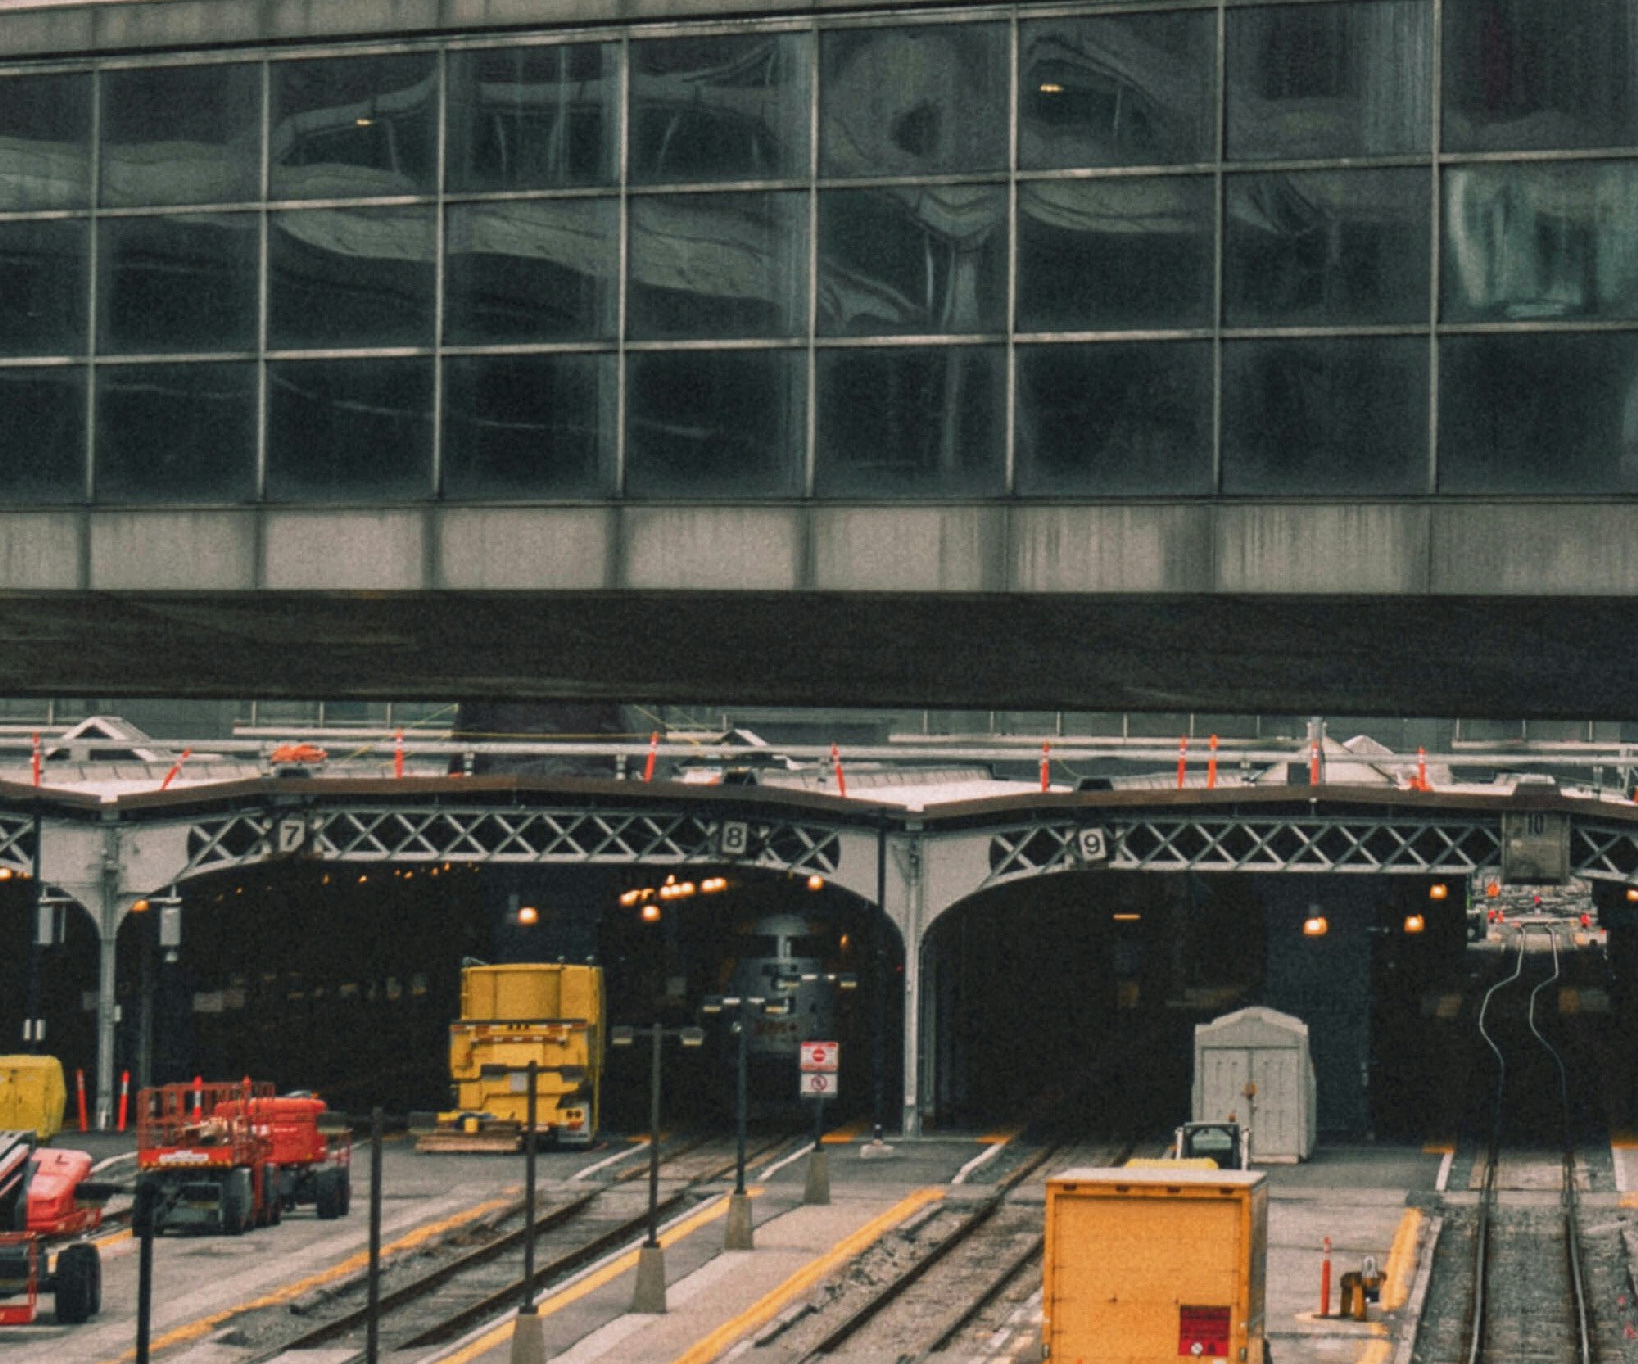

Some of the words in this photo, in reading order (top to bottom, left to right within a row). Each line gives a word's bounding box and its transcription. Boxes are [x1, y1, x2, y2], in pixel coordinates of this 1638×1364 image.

[1528, 814, 1544, 835] 10
[285, 825, 300, 846] 7
[728, 826, 742, 848] 8
[1084, 834, 1101, 854] 9
